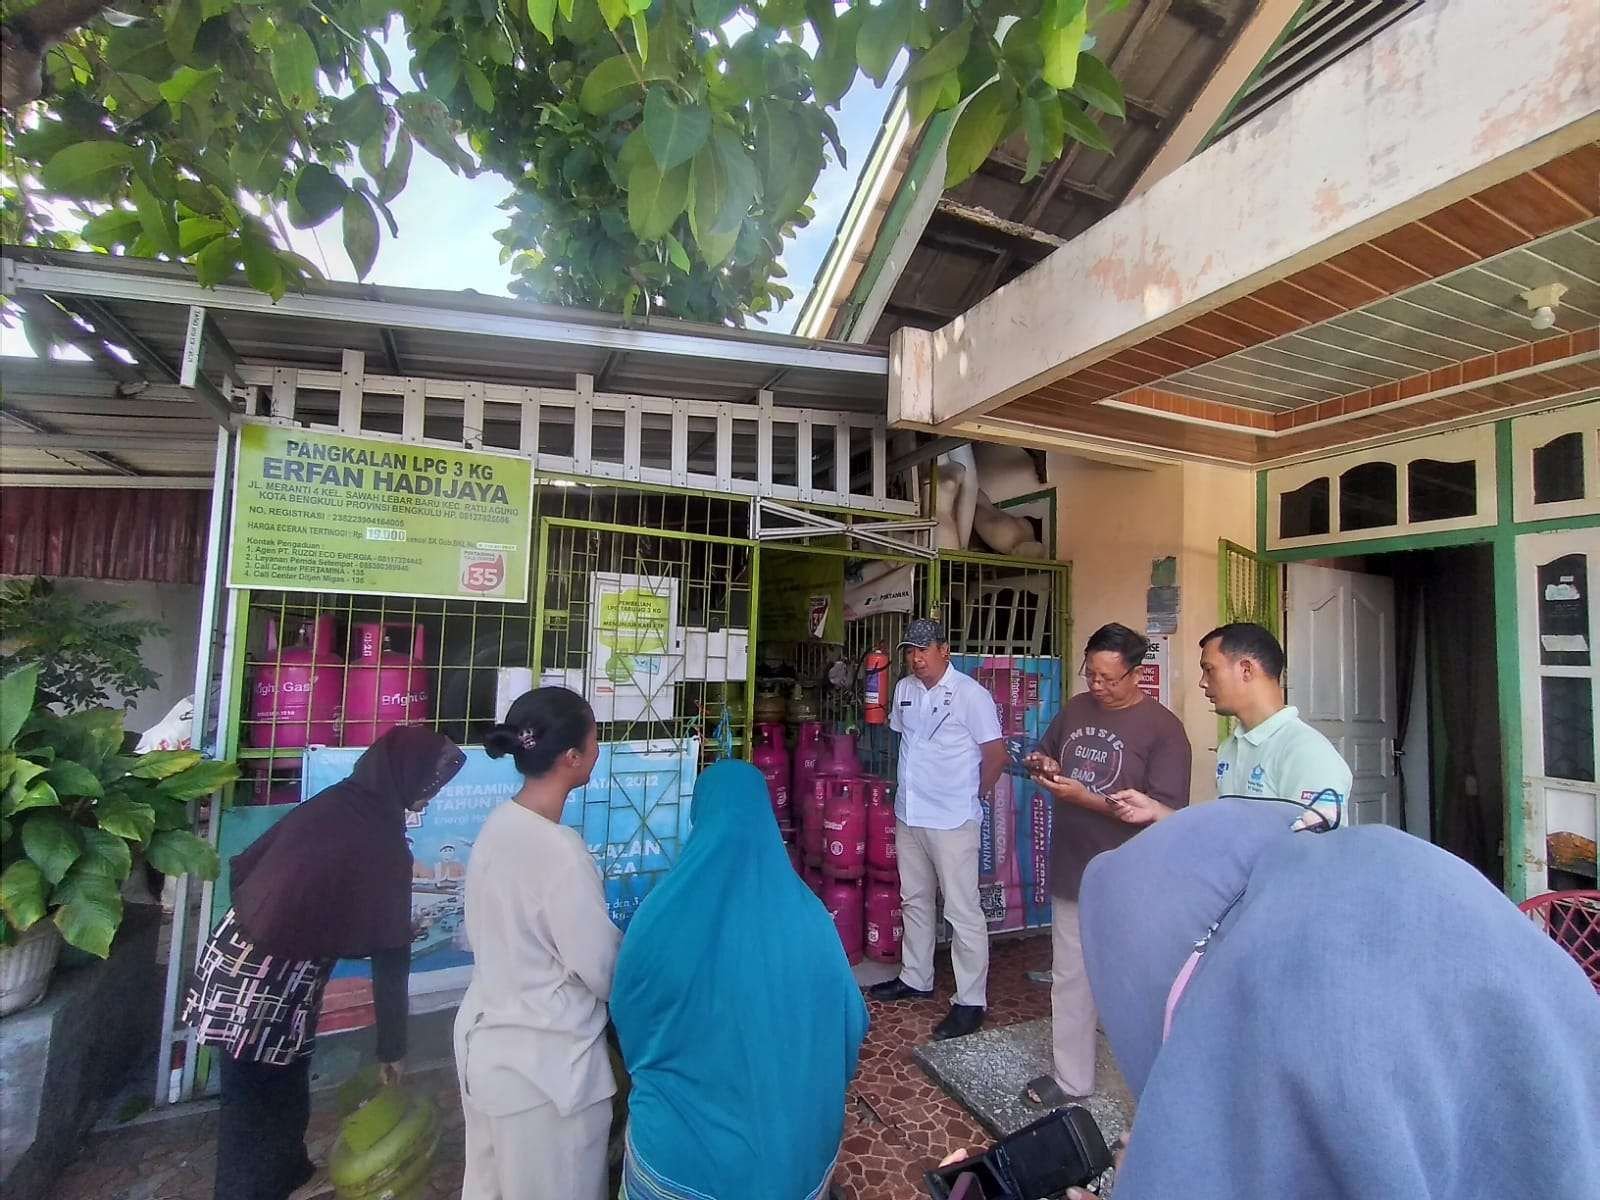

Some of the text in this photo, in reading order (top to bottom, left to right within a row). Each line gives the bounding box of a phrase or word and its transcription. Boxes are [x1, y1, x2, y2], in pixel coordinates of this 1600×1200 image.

[286, 440, 493, 481] PANGKALAN LPG 3 KG
[263, 456, 509, 505] ERFAN HADIJAYA
[248, 480, 261, 489] JL.
[265, 481, 312, 495] MERANTI
[313, 487, 319, 495] 4
[321, 487, 342, 498] KEL.
[346, 490, 379, 502] SAWAH
[382, 492, 413, 504] LEBAR
[415, 497, 440, 509] BARU
[464, 503, 488, 514] RATU
[489, 506, 519, 517] AGUNG
[259, 490, 286, 500] KOTA
[289, 493, 344, 508] BENGKULU
[346, 500, 390, 512] PROVINSI
[392, 505, 442, 518] BENGKULU
[249, 506, 265, 515] NO.
[268, 507, 326, 521] REGISTRASI
[248, 521, 275, 531] HARGA
[276, 524, 307, 534] ECERAN
[309, 527, 348, 538] TERTINGGI
[248, 537, 320, 550] Kontak Pengaduan
[255, 547, 276, 556] Agen
[255, 555, 287, 564] Layanan
[254, 562, 270, 570] Call
[272, 563, 299, 572] Center
[300, 565, 345, 575] PERTAMINA
[271, 571, 296, 579] Center
[282, 681, 312, 693] Gas
[382, 692, 418, 707] Bright
[1070, 726, 1124, 751] MUSIC
[1075, 745, 1108, 763] GUITAR
[1071, 767, 1096, 782] BAND
[435, 797, 491, 811] TAHUN
[980, 806, 993, 871] PERTAMINA
